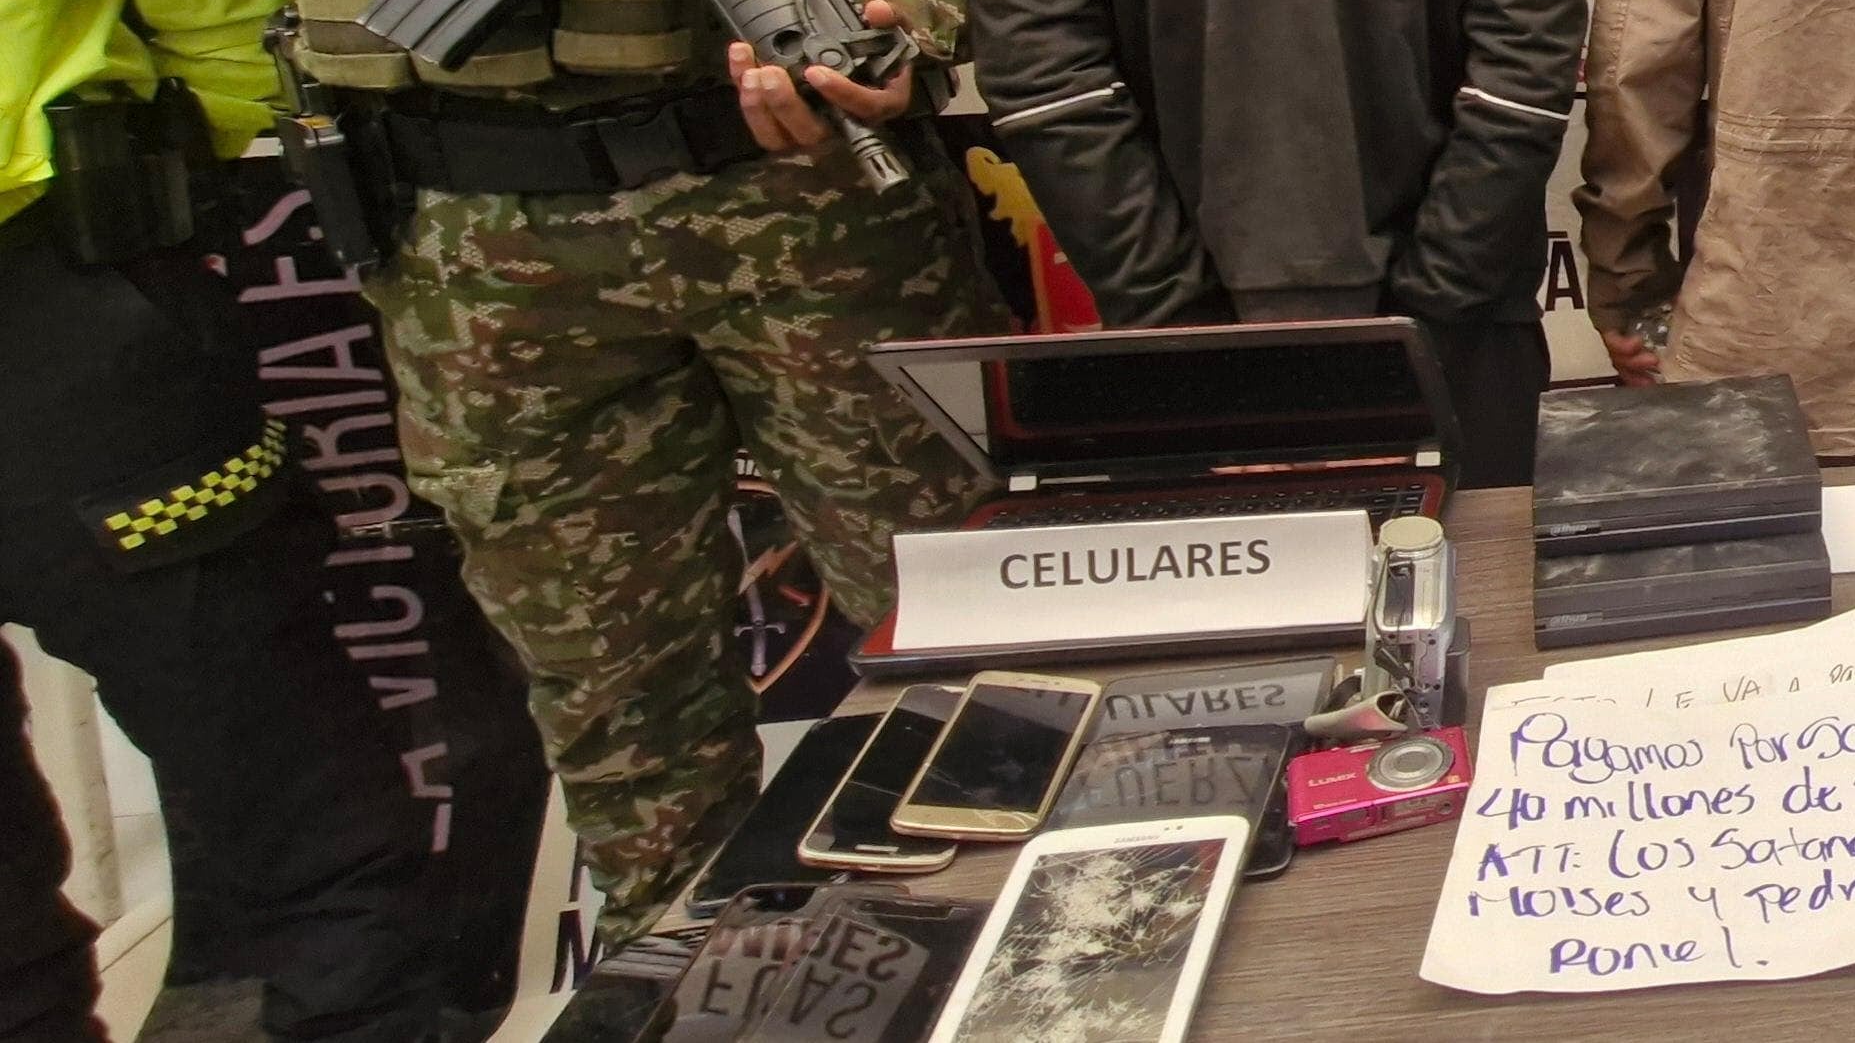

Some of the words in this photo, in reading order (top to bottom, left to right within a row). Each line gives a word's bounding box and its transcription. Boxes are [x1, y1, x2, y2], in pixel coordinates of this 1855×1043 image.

[1000, 538, 1271, 590] CELULARES
[1476, 788, 1545, 830] 40
[1782, 765, 1843, 812] de
